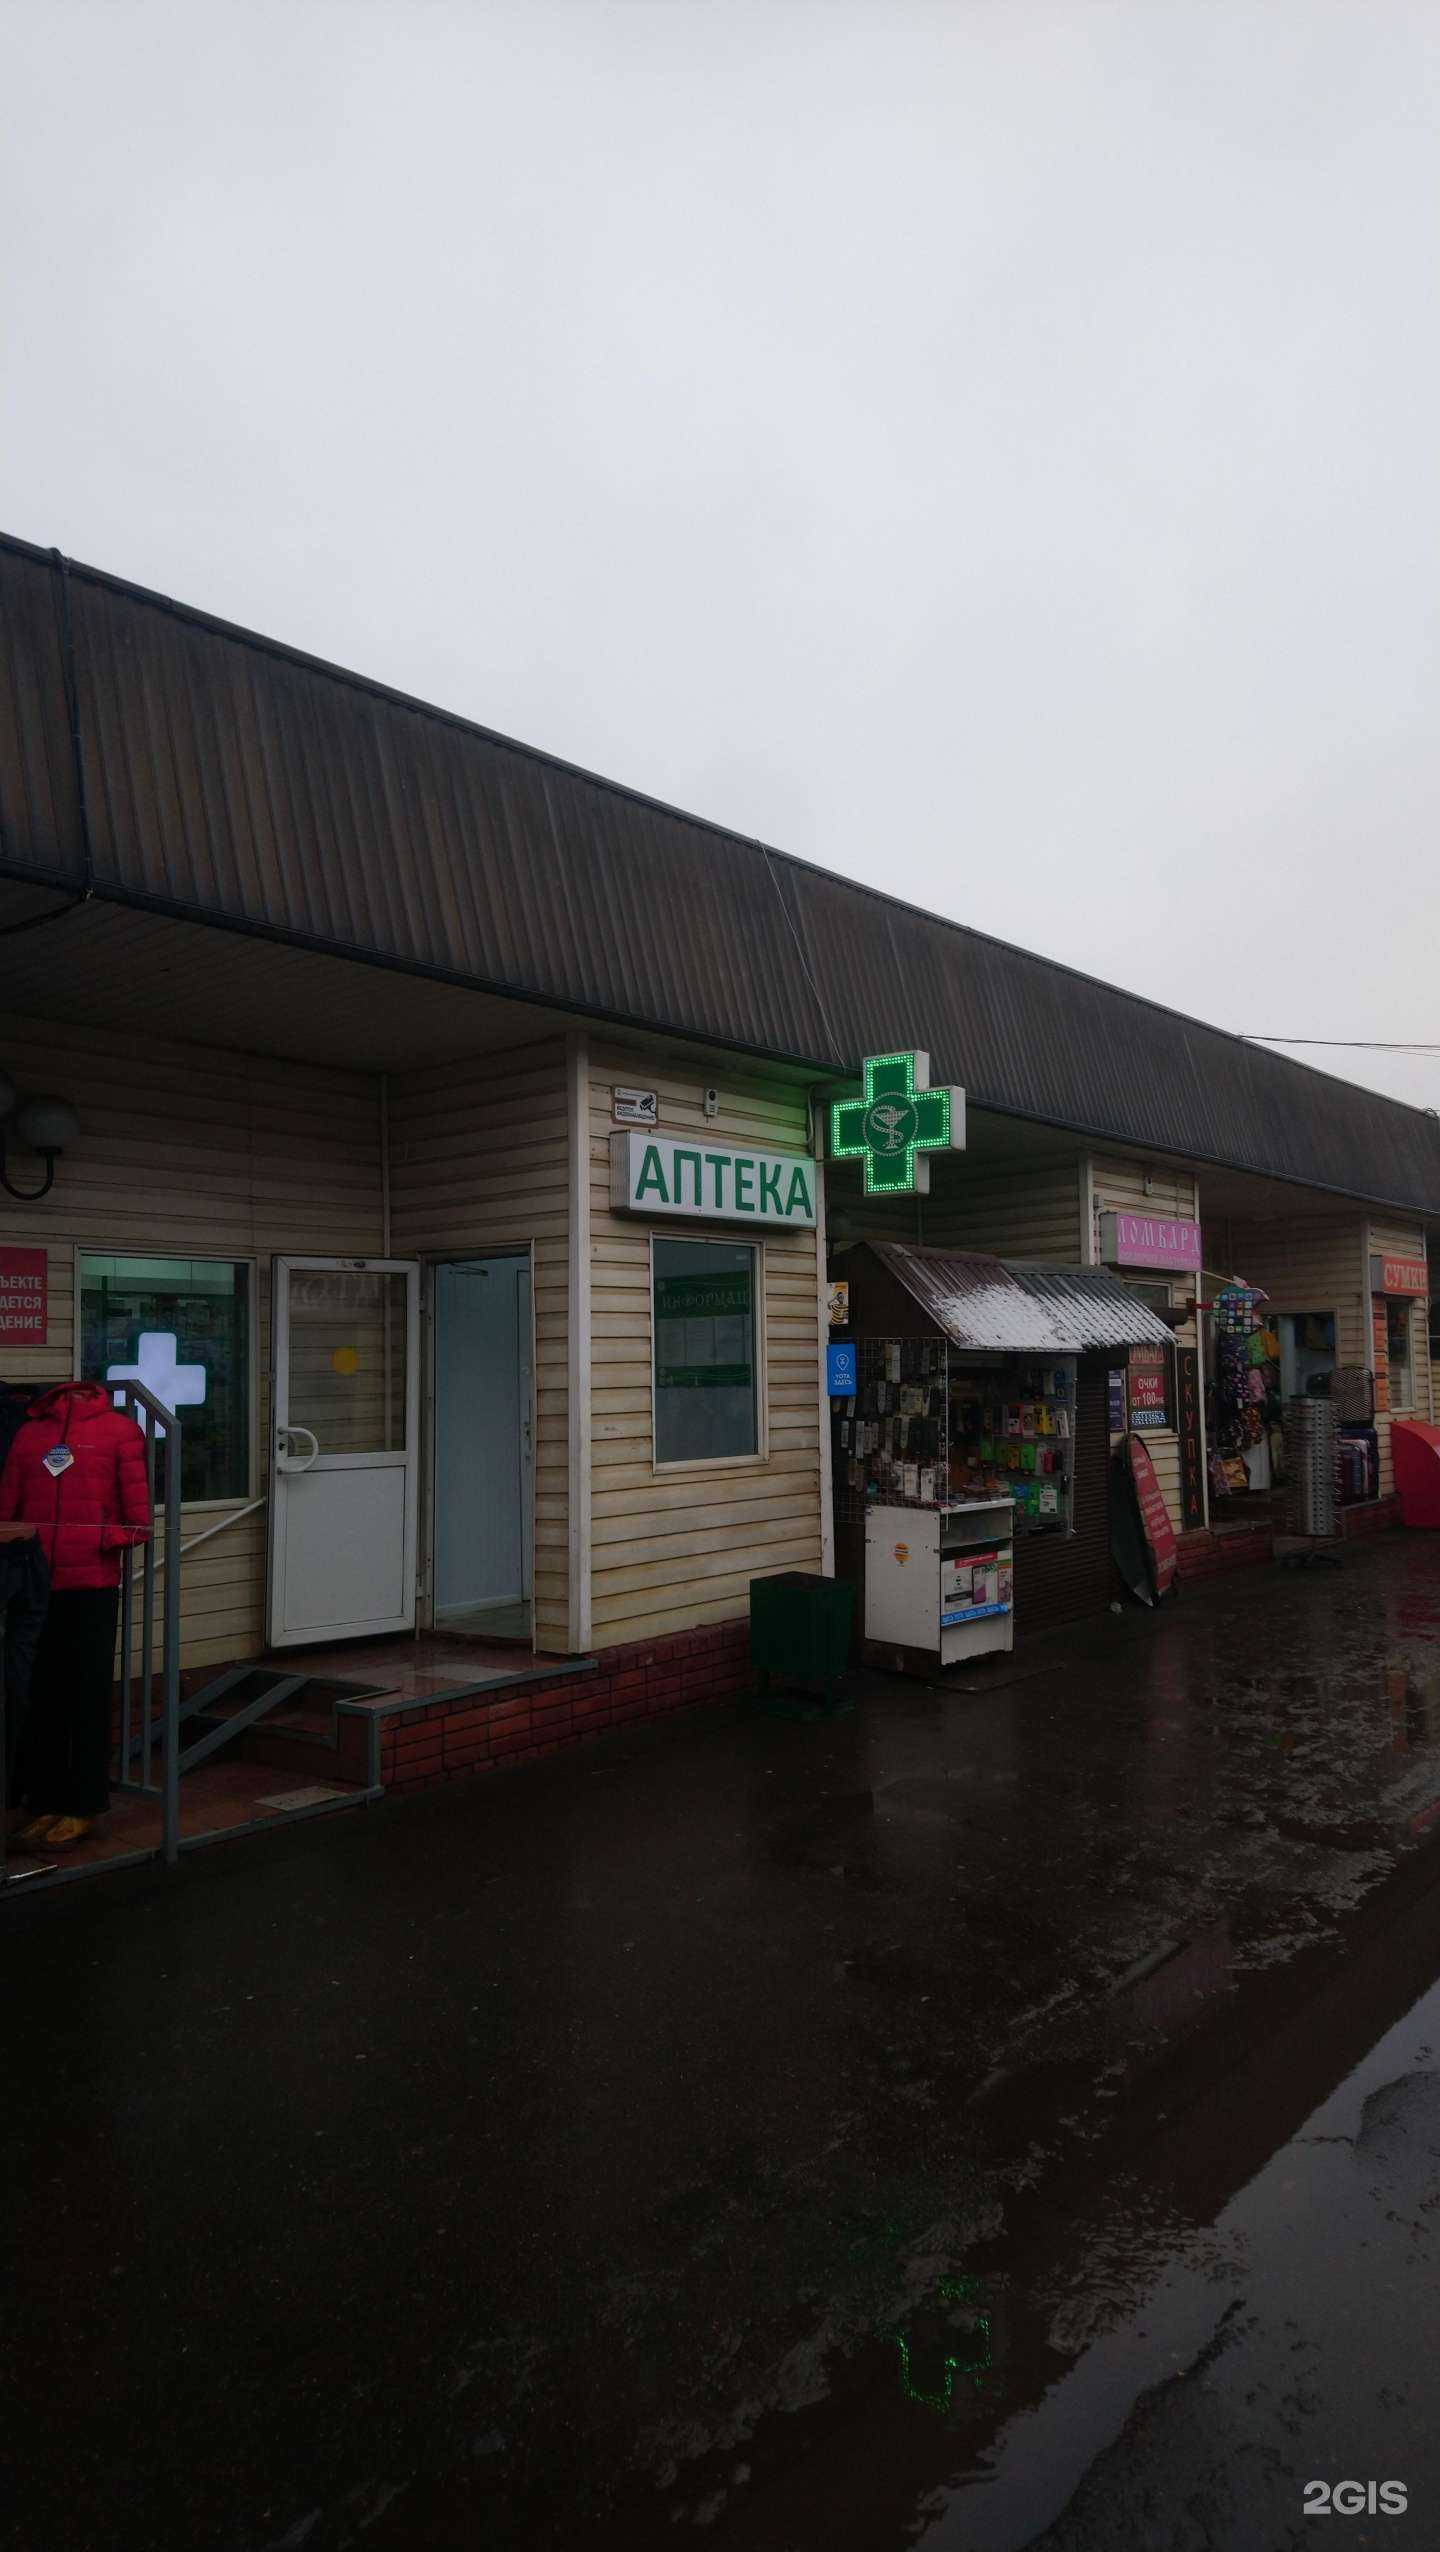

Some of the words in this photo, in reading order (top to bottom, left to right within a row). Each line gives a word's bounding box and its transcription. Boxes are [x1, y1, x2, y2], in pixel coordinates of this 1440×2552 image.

[635, 1145, 813, 1218] АПТЕКА
[1383, 1263, 1428, 1291] СУМКИ
[1138, 1377, 1159, 1390] ОЧКИ
[1183, 1355, 1199, 1515] СКУПКА
